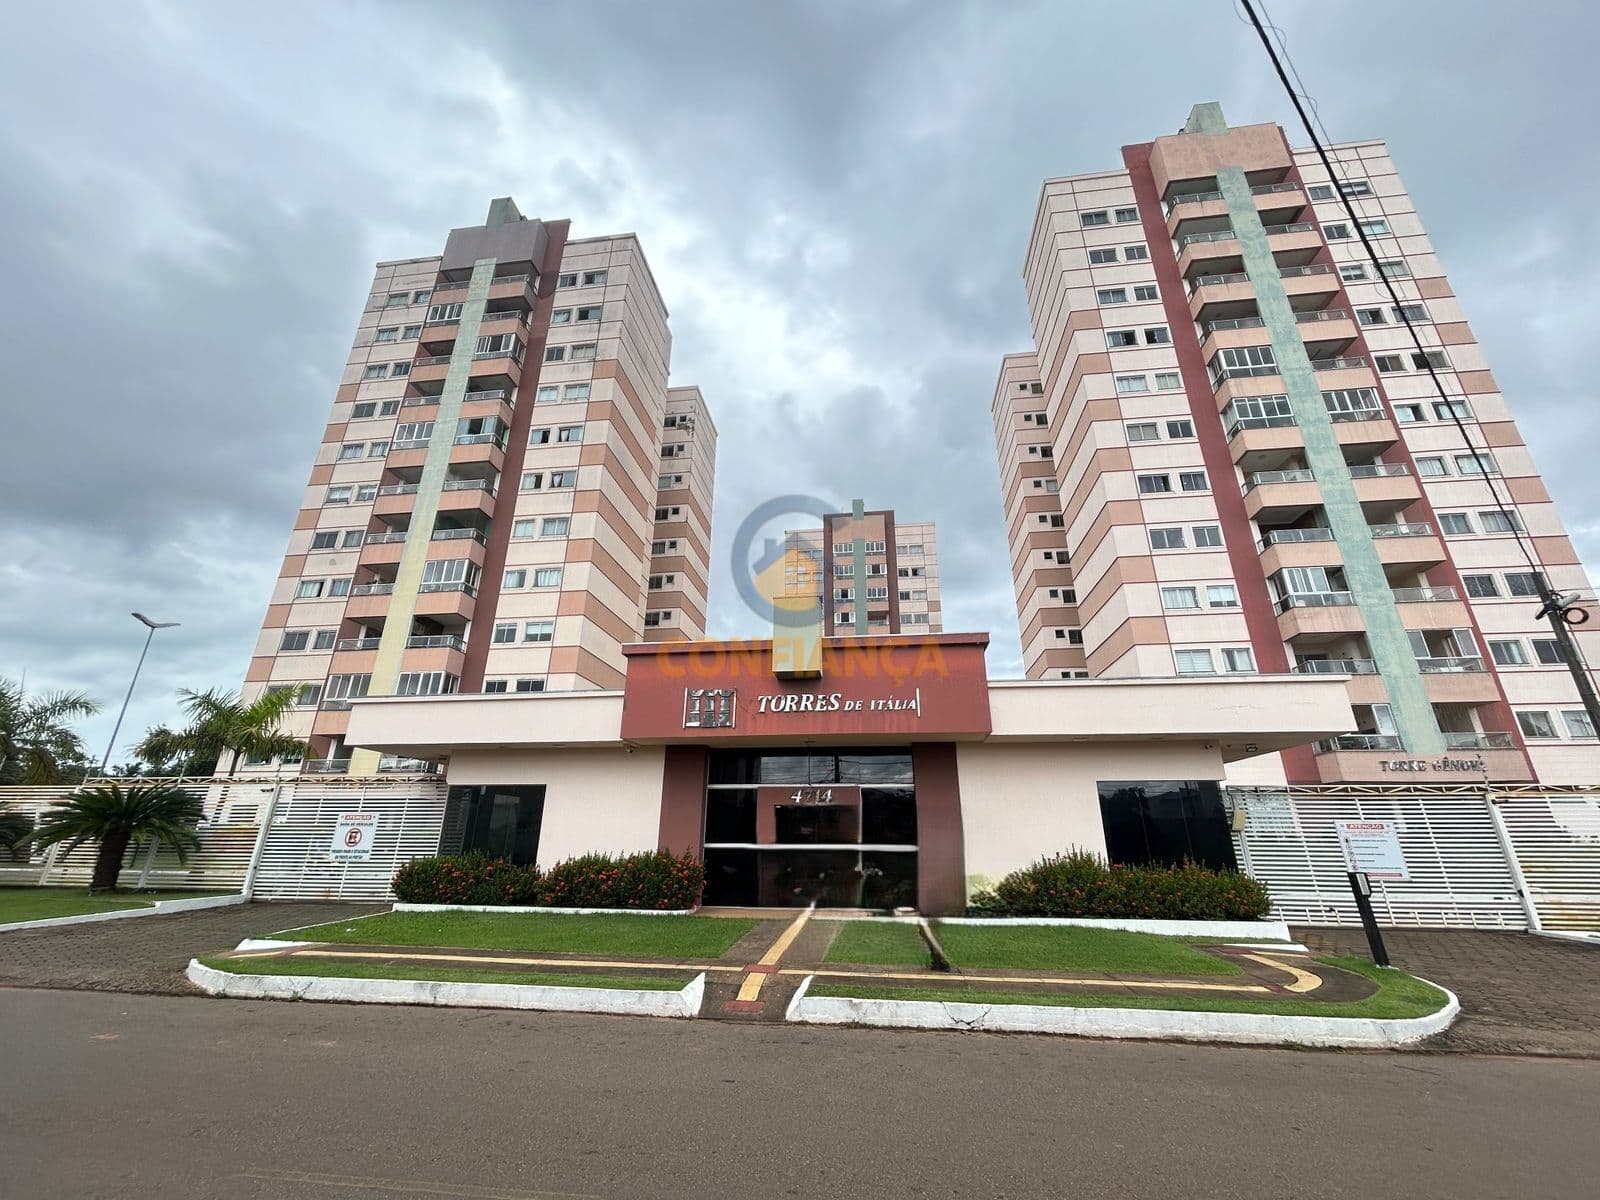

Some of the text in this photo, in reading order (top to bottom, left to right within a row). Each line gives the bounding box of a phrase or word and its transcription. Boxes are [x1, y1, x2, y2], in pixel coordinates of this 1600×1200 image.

[757, 692, 917, 713] TORRES DE ITÁLIA
[1379, 761, 1427, 772] TORRE
[791, 789, 832, 804] 4714
